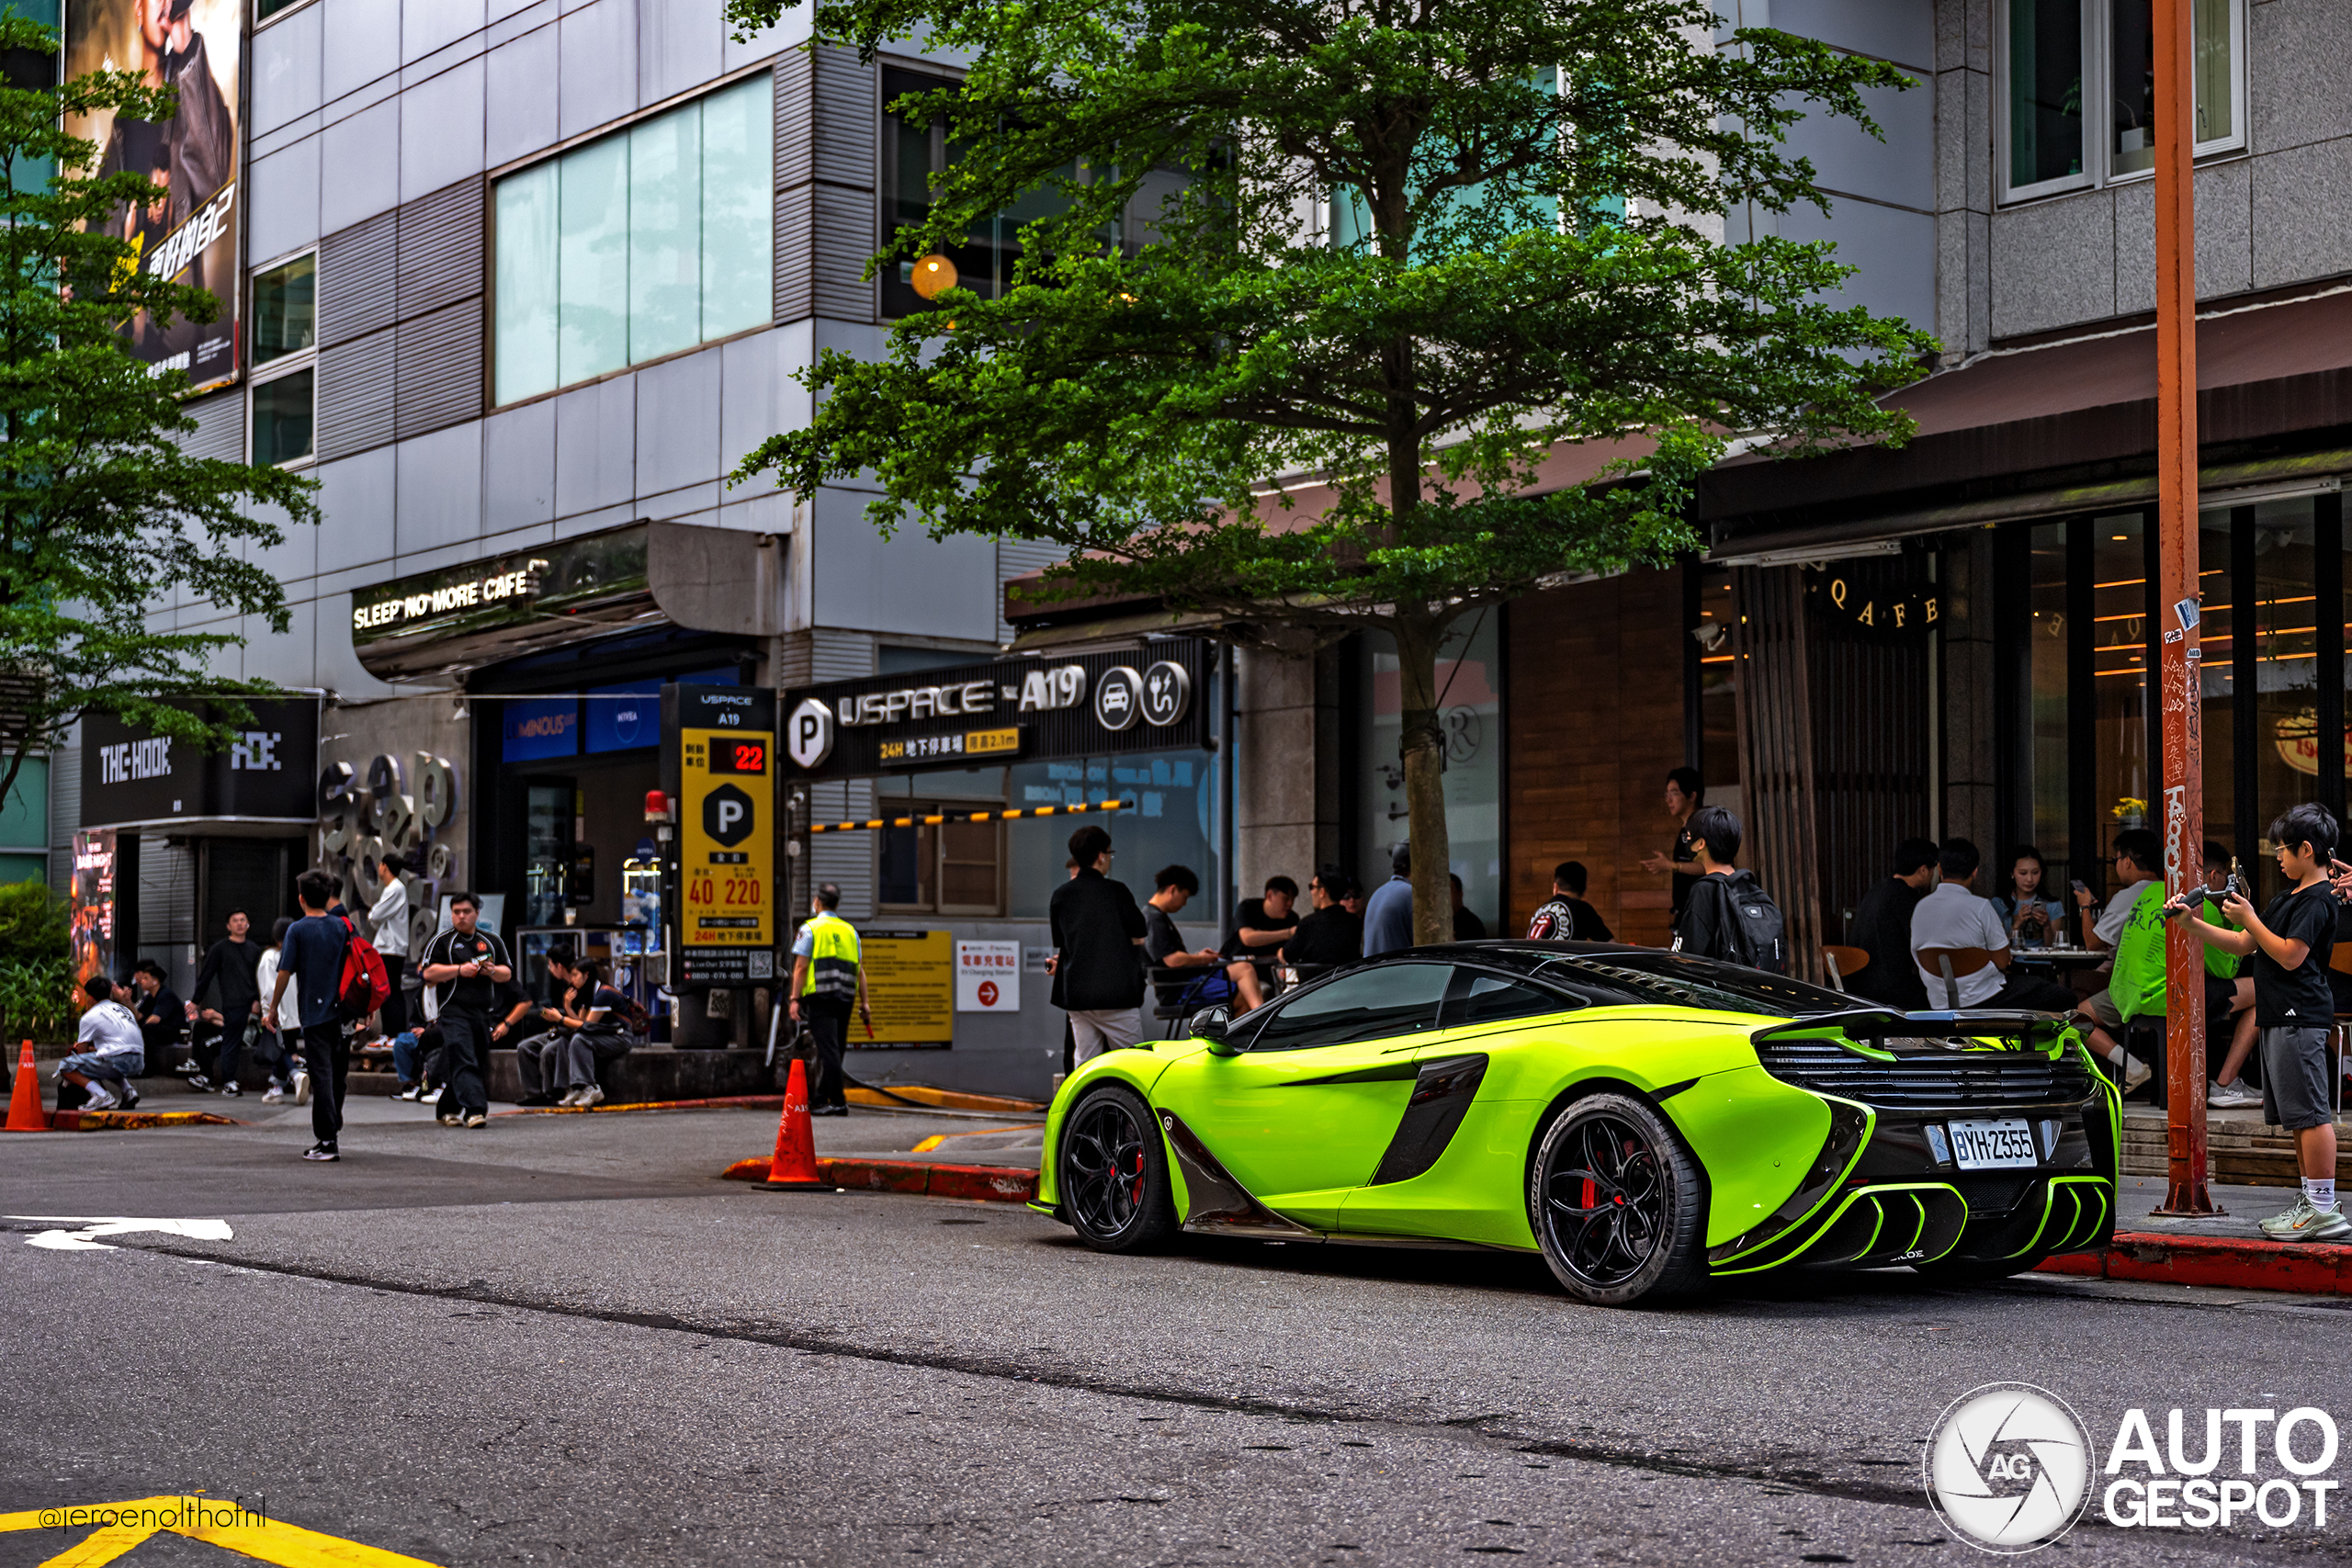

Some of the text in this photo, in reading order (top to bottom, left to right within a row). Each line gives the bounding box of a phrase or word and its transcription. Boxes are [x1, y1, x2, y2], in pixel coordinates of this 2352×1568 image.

[149, 183, 236, 282] 更好的自己
[354, 570, 527, 630] SLEEP NO MORE CAFE
[701, 694, 753, 705] USPACE
[839, 680, 995, 728] USPACE
[617, 711, 638, 723] NIVEA
[718, 713, 741, 726] A19
[800, 714, 819, 755] P
[880, 743, 904, 760] 24H
[906, 734, 963, 758] 地下停車場
[735, 745, 763, 771] 22
[718, 800, 744, 833] P
[690, 879, 761, 905] 40 220
[695, 931, 763, 942] 24H 地下停車場
[962, 954, 1016, 967] 電車充電站
[2224, 1089, 2244, 1099] HOKA
